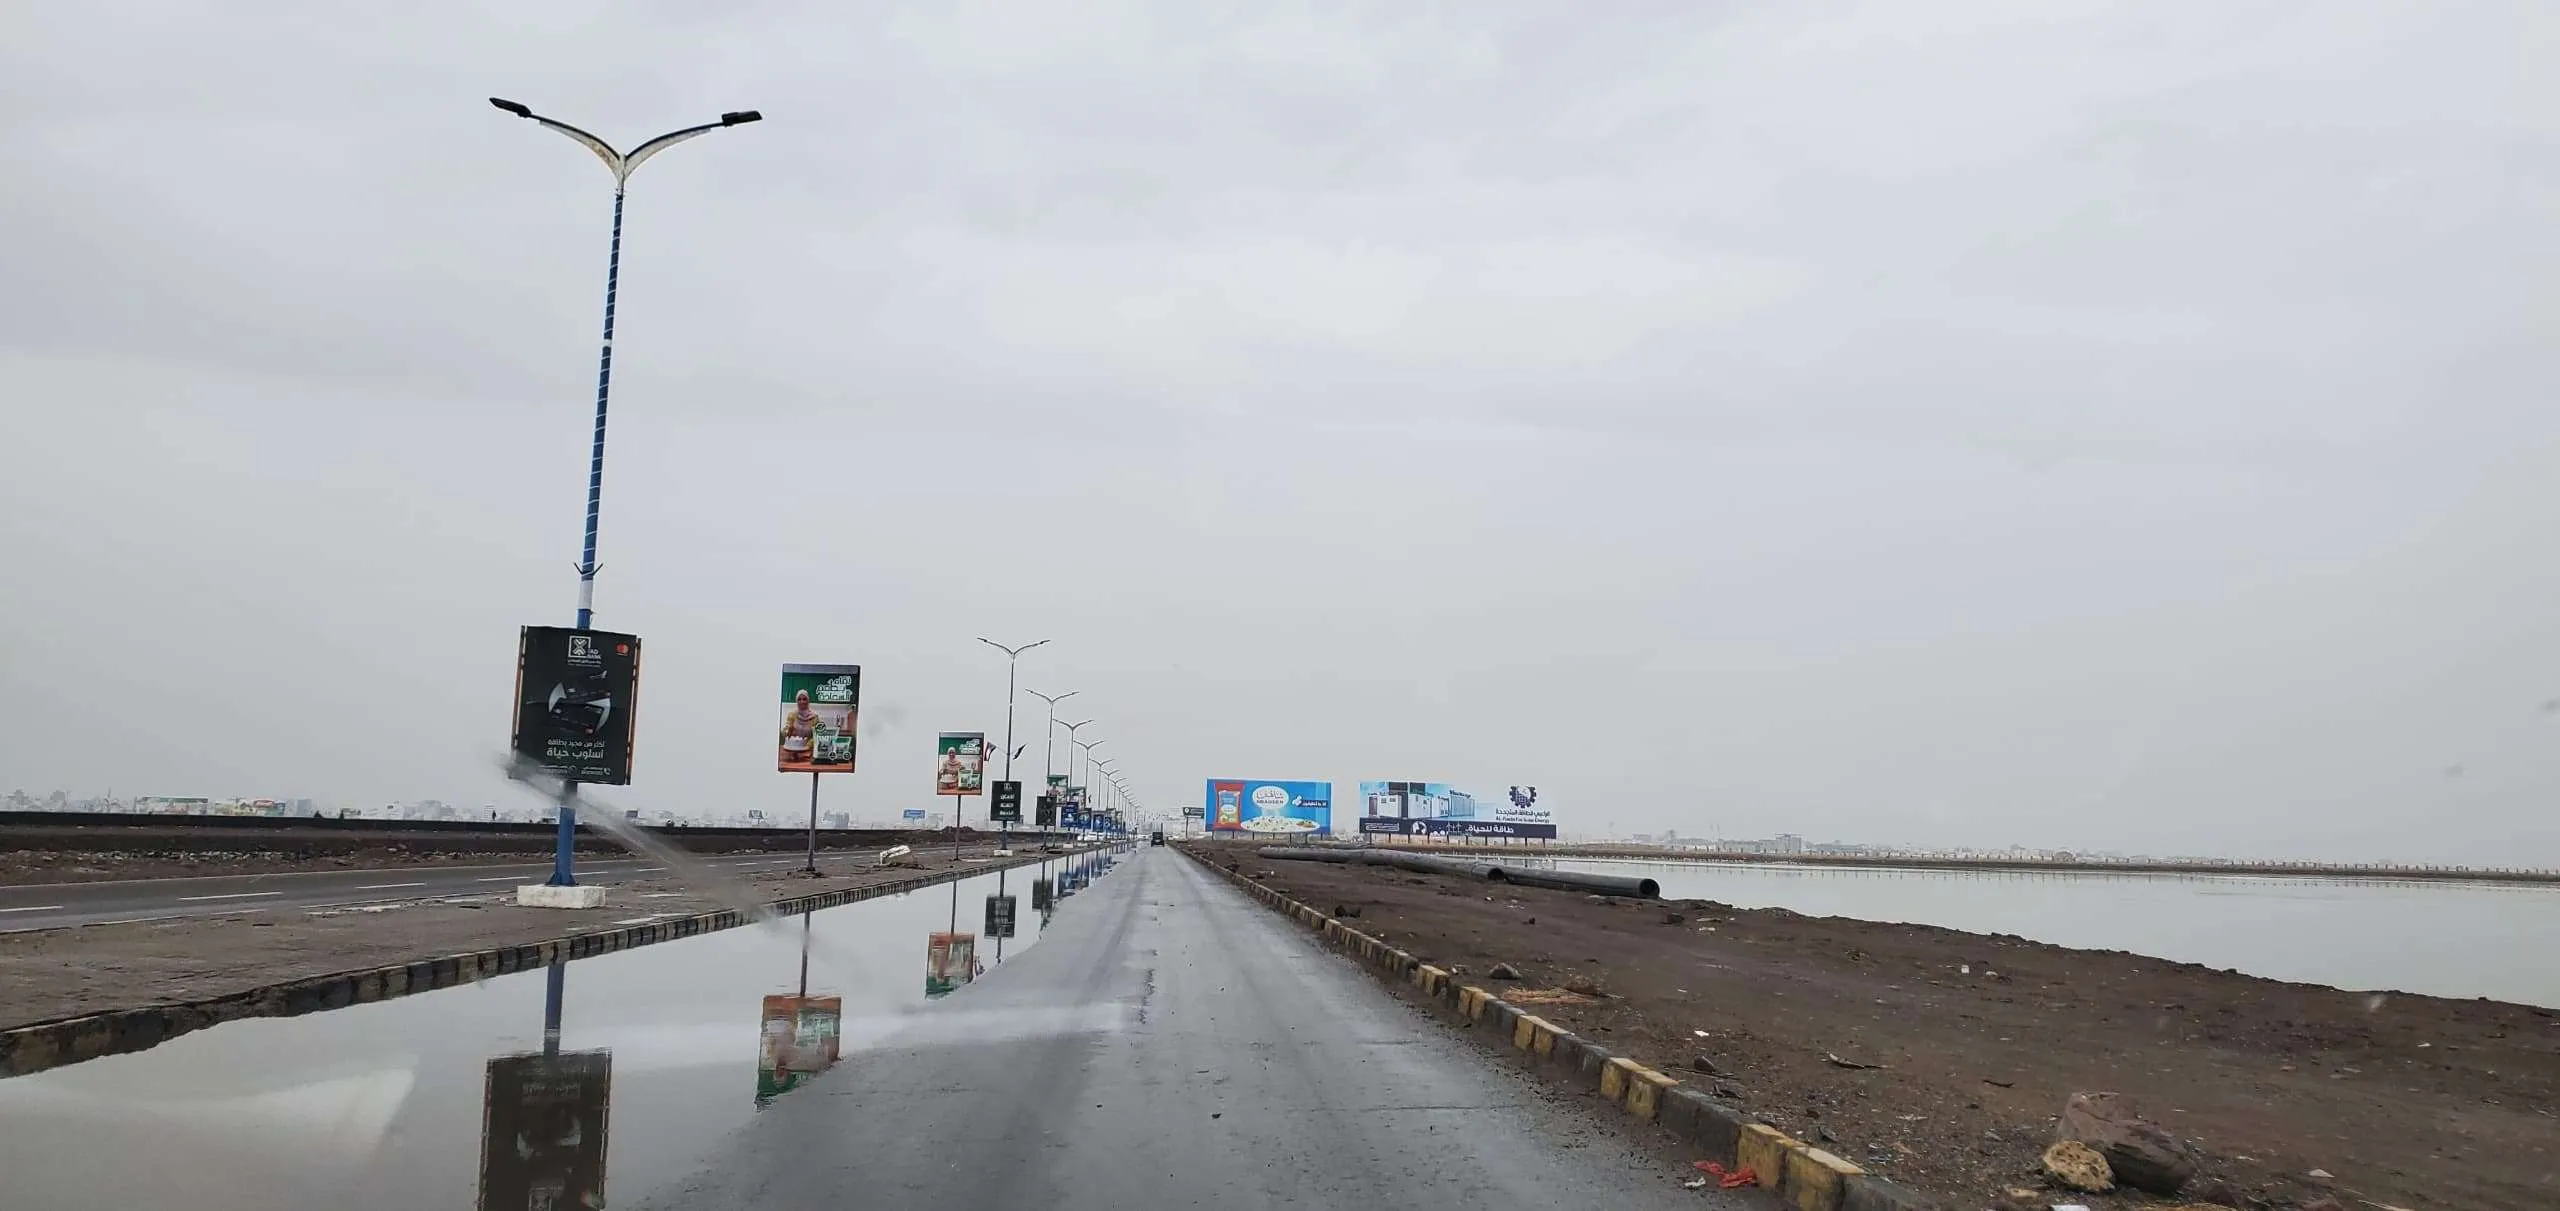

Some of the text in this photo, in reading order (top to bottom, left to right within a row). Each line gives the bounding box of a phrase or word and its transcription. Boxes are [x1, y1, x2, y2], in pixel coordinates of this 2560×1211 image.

[547, 738, 568, 748] بطاقة
[568, 739, 583, 748] مجرد
[546, 747, 604, 760] أسلوب حياة
[1493, 824, 1514, 833] طاقة
